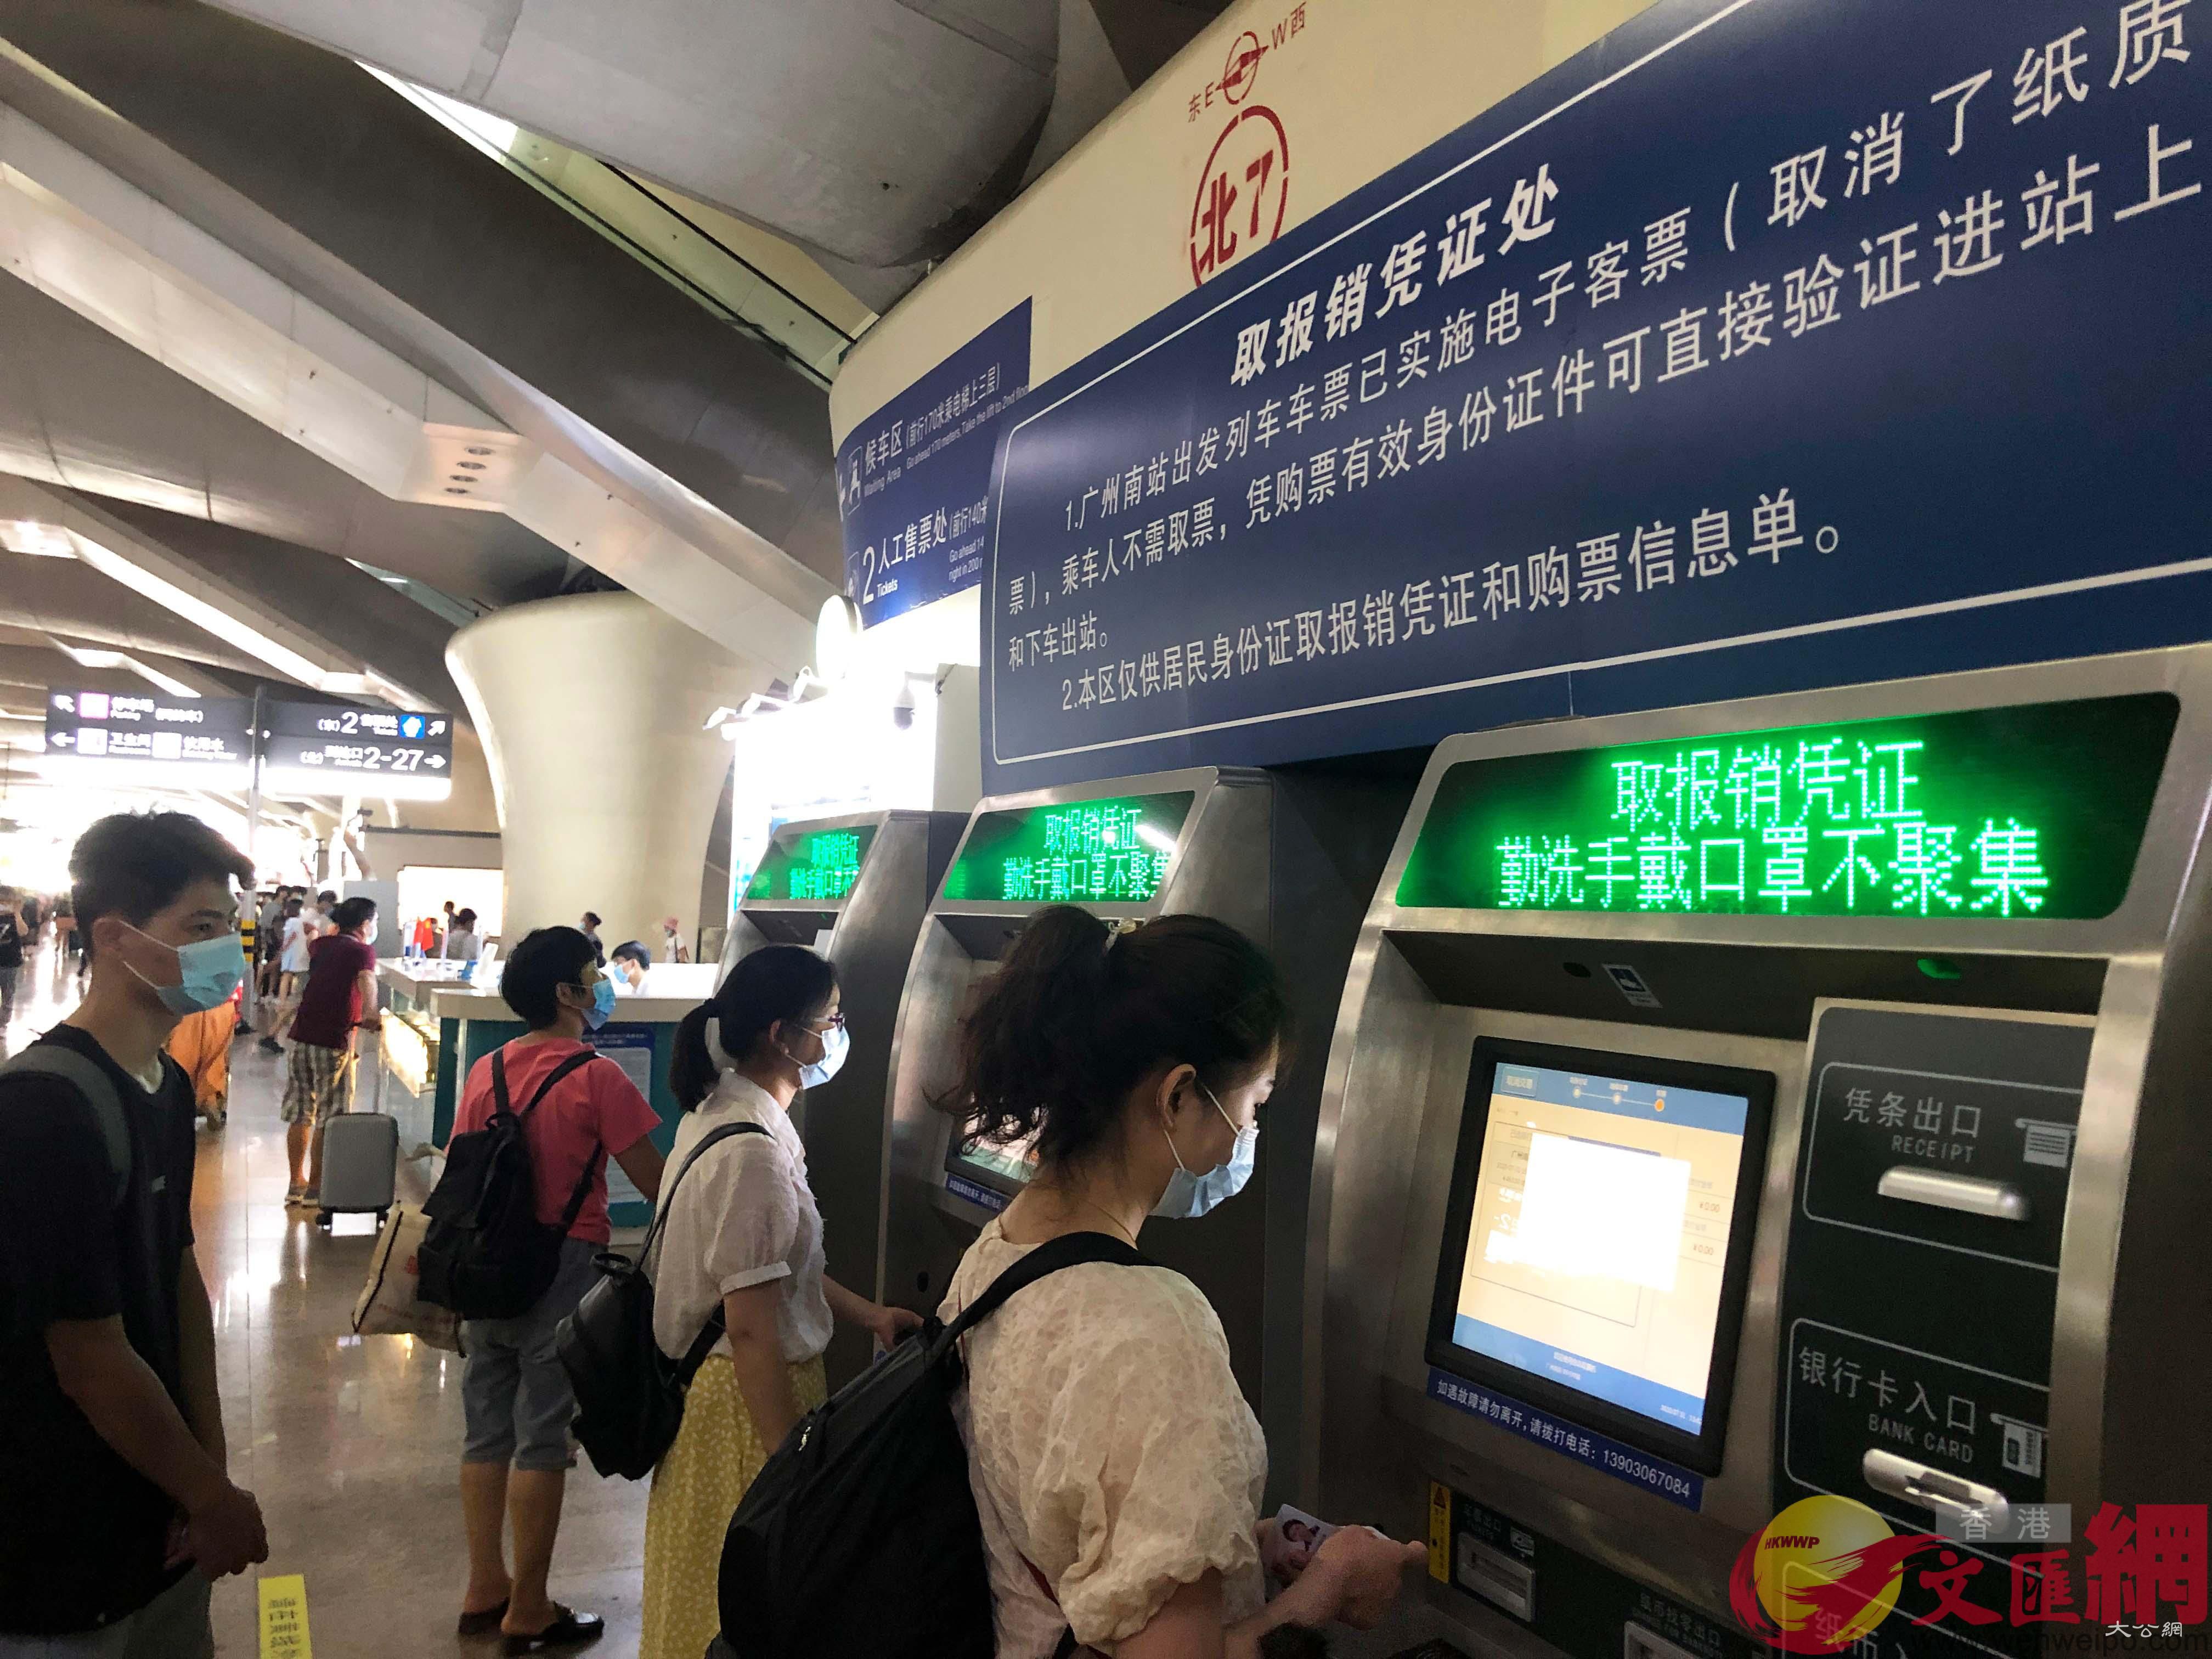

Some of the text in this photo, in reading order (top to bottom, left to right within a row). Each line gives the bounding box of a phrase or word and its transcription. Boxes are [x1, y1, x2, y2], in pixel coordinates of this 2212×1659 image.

[1231, 163, 1559, 386] 取报销凭证处
[866, 419, 903, 476] 候车区
[863, 546, 875, 605] 2
[879, 507, 947, 574] 人工售票处
[950, 549, 958, 562] Go
[959, 539, 976, 559] ahead
[877, 578, 898, 597] Tickets
[1063, 488, 1839, 711] 2.本区仅供居民身份证取报销凭证和购票信息单。
[1009, 613, 1107, 672] 和下车出站。
[341, 712, 358, 734] 2
[363, 746, 424, 771] 2-27
[1611, 738, 1923, 831] 取报销凭证
[1043, 805, 1141, 855] 取报销凭证
[1496, 817, 2049, 916] 勤洗手戴口罩不聚集
[1844, 1087, 1981, 1138] 凭条出口
[1892, 1135, 1975, 1163] RECEIPT
[1798, 1346, 1976, 1436] 银行卡入口
[1868, 1414, 1973, 1464] BANK CARD
[1603, 1449, 1690, 1498] 13903067084
